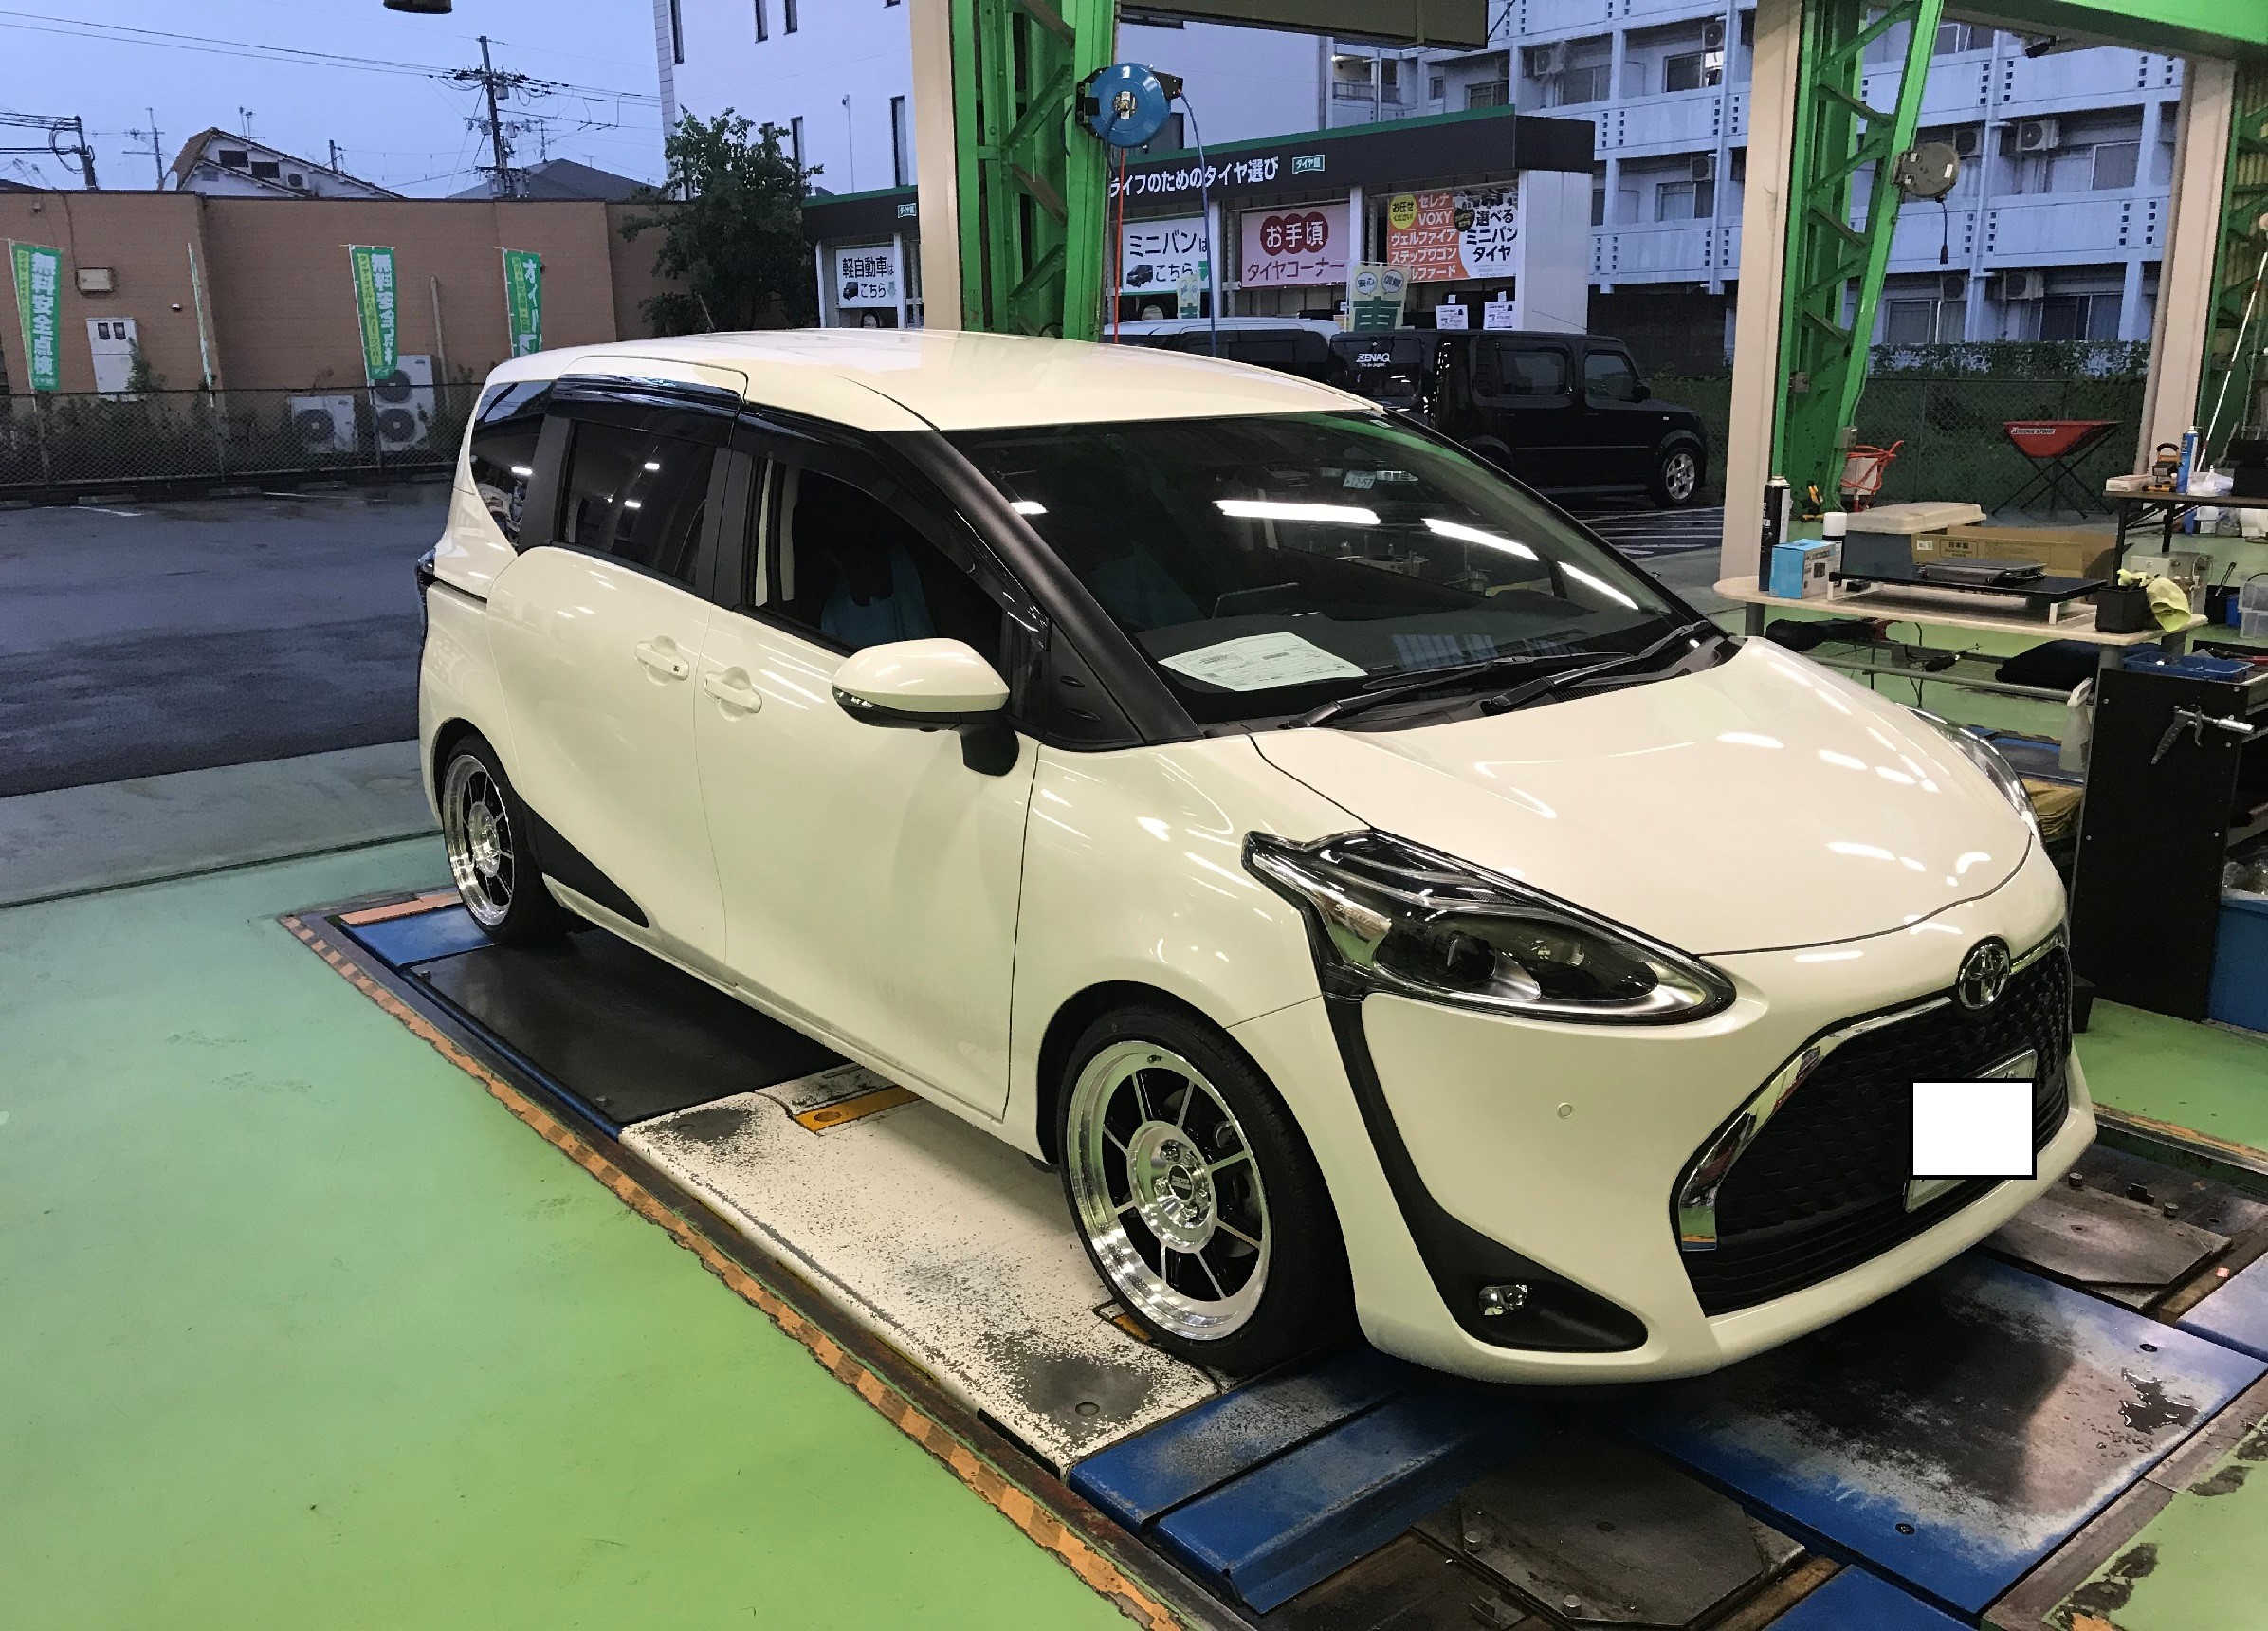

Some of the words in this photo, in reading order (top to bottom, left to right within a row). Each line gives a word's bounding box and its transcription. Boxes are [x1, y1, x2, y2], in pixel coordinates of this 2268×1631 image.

[1392, 201, 1415, 212] お任せ
[1419, 193, 1450, 208] セレナ
[1418, 211, 1453, 226] VOXY
[1475, 209, 1514, 227] 選べる
[1266, 220, 1324, 248] お手頃
[1391, 229, 1457, 246] ヴェルファイア
[1466, 226, 1517, 245] ミニバン
[1129, 229, 1208, 257] ミニバンは
[1391, 247, 1457, 264] ステップワゴン
[1473, 245, 1511, 263] タイヤ
[842, 256, 894, 278] 軽自動車は
[1247, 257, 1345, 282] タイヤコーナー
[1411, 265, 1457, 280] ルファード
[860, 283, 887, 298] こちら
[1358, 277, 1375, 288] 安心
[1356, 353, 1391, 363] ZENAQ
